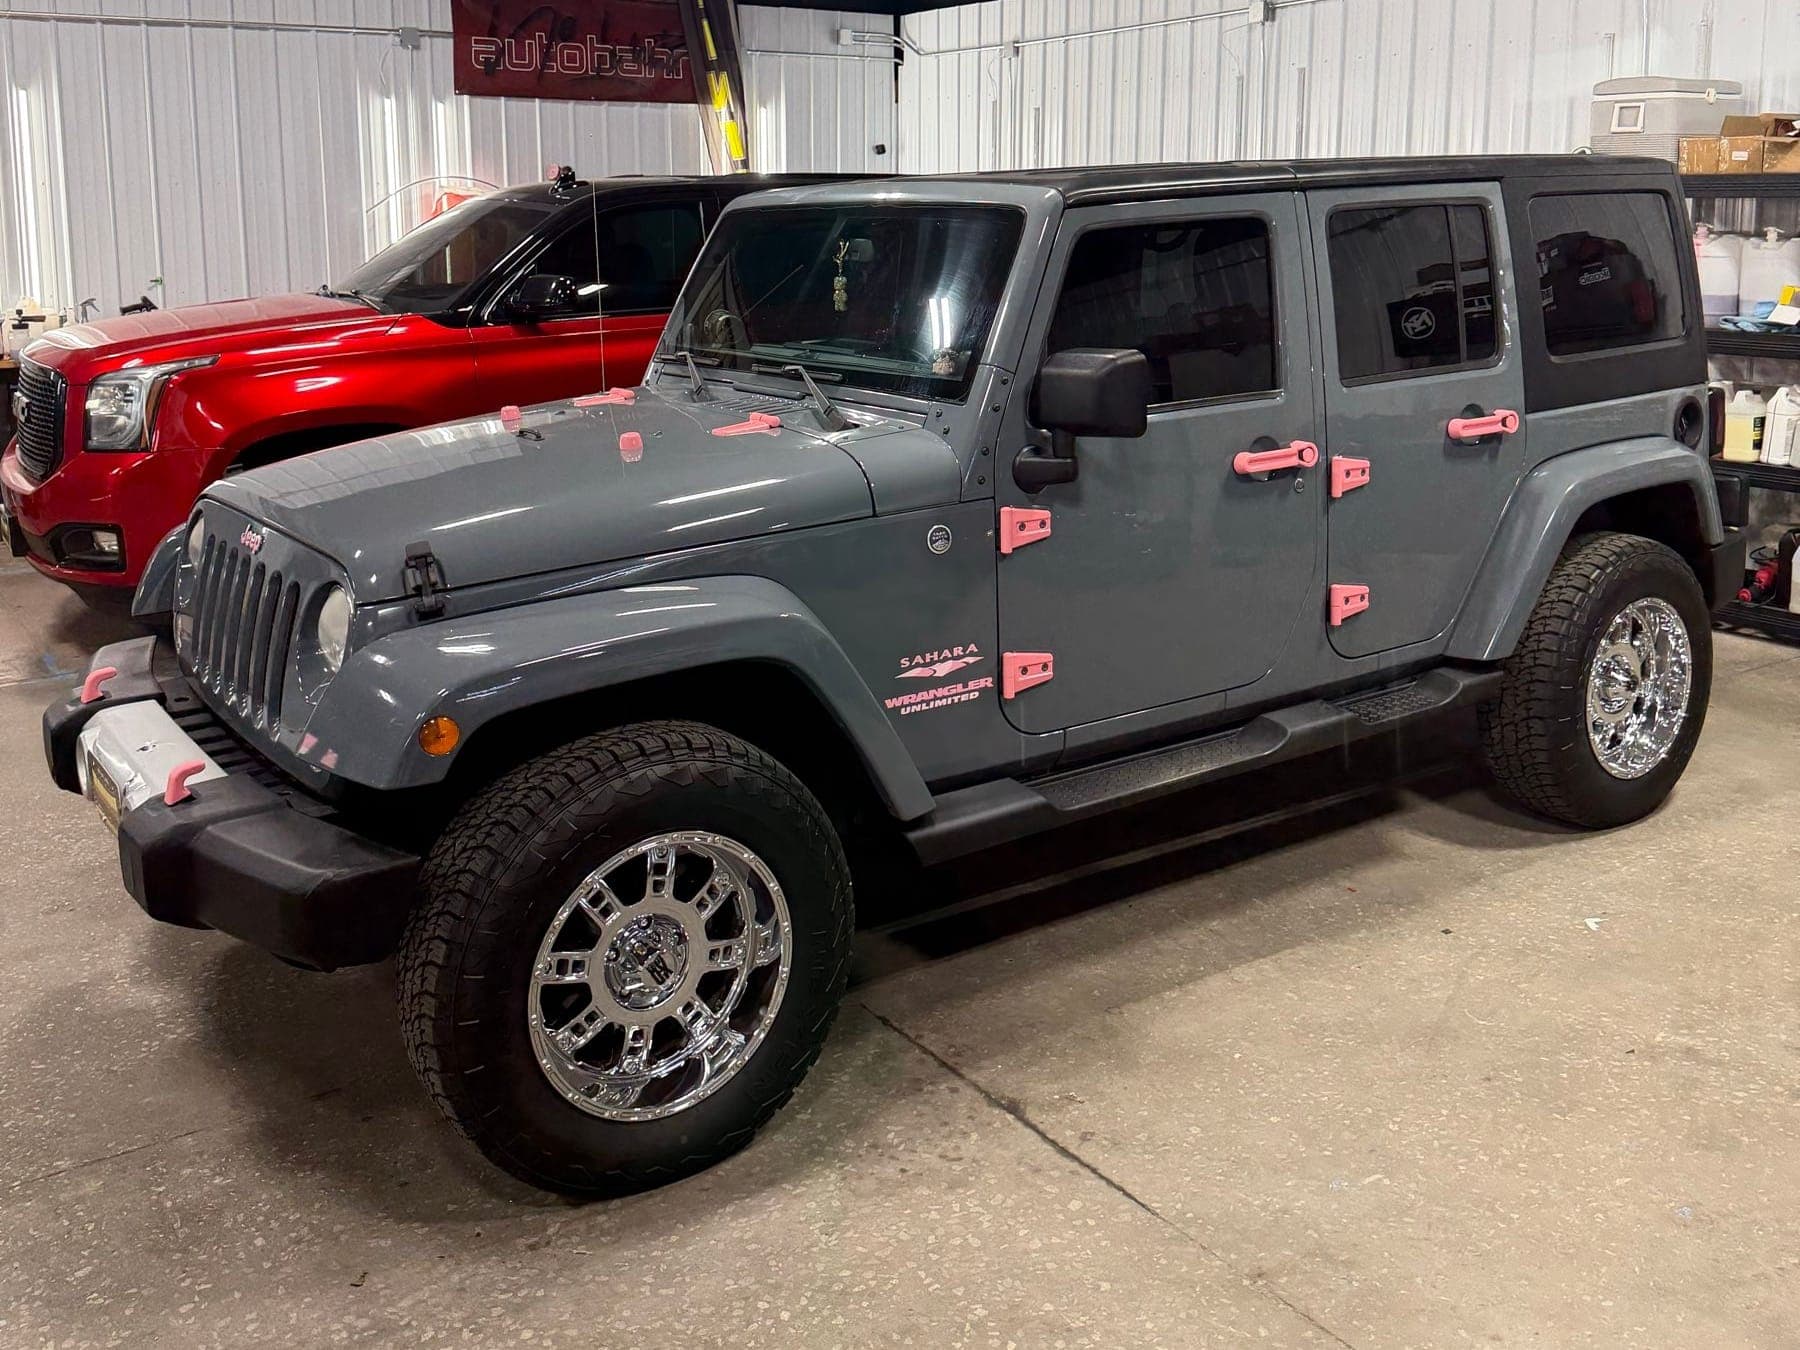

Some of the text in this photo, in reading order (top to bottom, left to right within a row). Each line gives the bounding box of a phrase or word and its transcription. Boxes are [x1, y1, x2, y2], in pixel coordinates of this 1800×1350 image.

[241, 523, 262, 553] Jeep
[900, 643, 978, 668] SAHARA
[885, 676, 994, 709] WRANGLER
[900, 691, 980, 715] UNLIMITED
